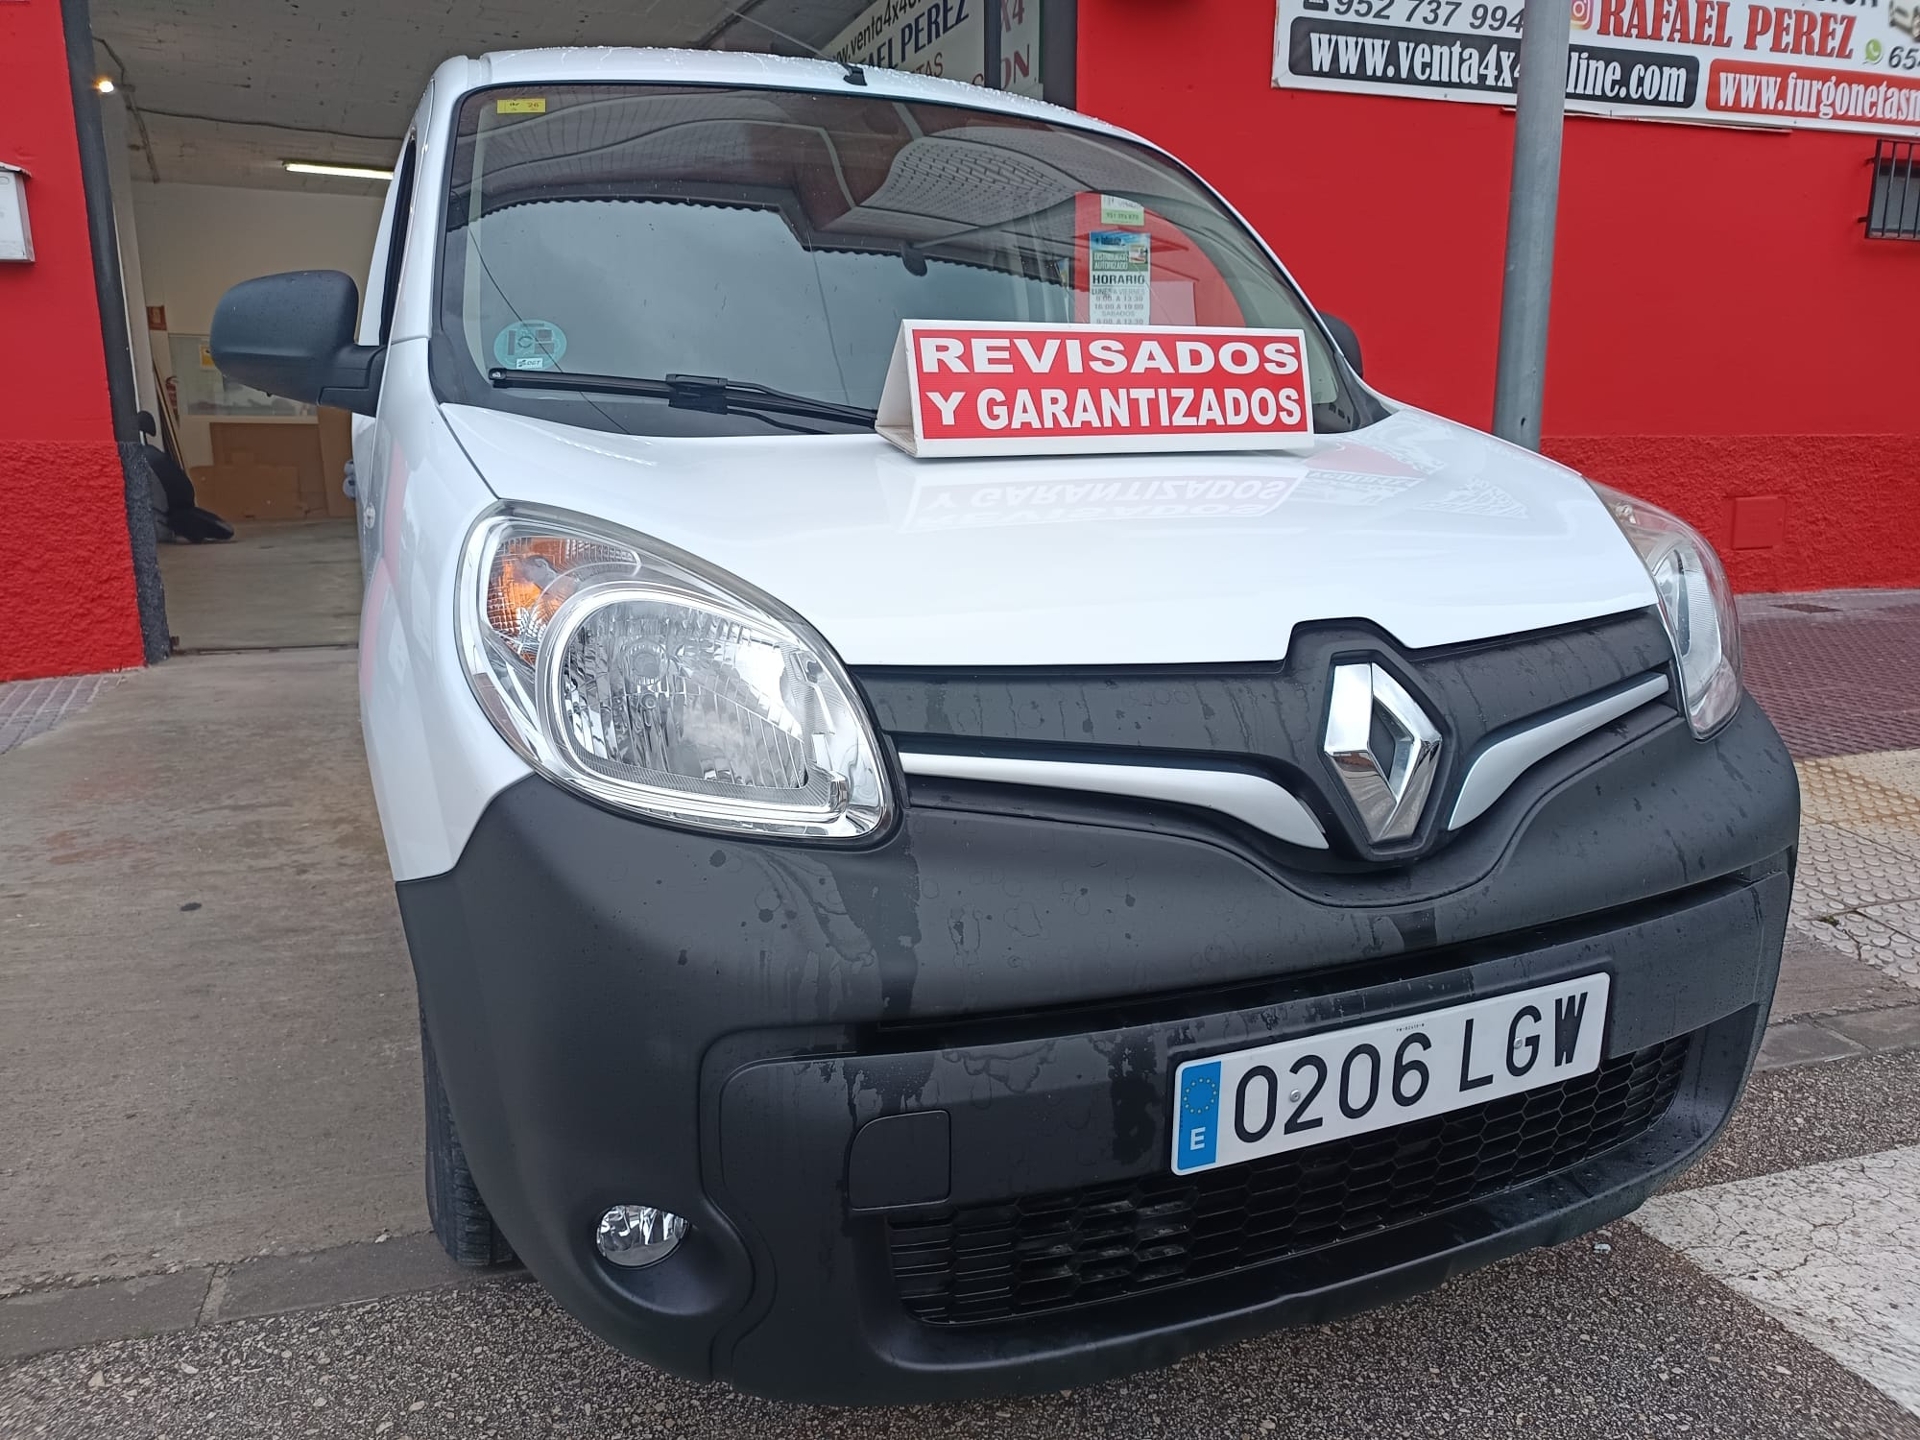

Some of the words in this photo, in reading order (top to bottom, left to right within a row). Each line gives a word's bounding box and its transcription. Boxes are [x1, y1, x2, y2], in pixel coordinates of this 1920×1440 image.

[901, 0, 969, 63] PEREZ
[1334, 0, 1395, 20] 952
[1403, 0, 1461, 27] 737
[1469, 4, 1524, 33] 994
[1597, 0, 1732, 48] RAFAEL
[1744, 4, 1857, 60] PEREZ
[1889, 46, 1920, 70] 65
[1092, 274, 1145, 285] HORARIO
[918, 337, 1299, 375] REVISADOS
[928, 391, 966, 425] Y
[976, 387, 1302, 430] GARANTIZADOS
[1234, 1032, 1432, 1144] 0206
[1459, 991, 1588, 1093] LGW
[1190, 1126, 1206, 1151] E
